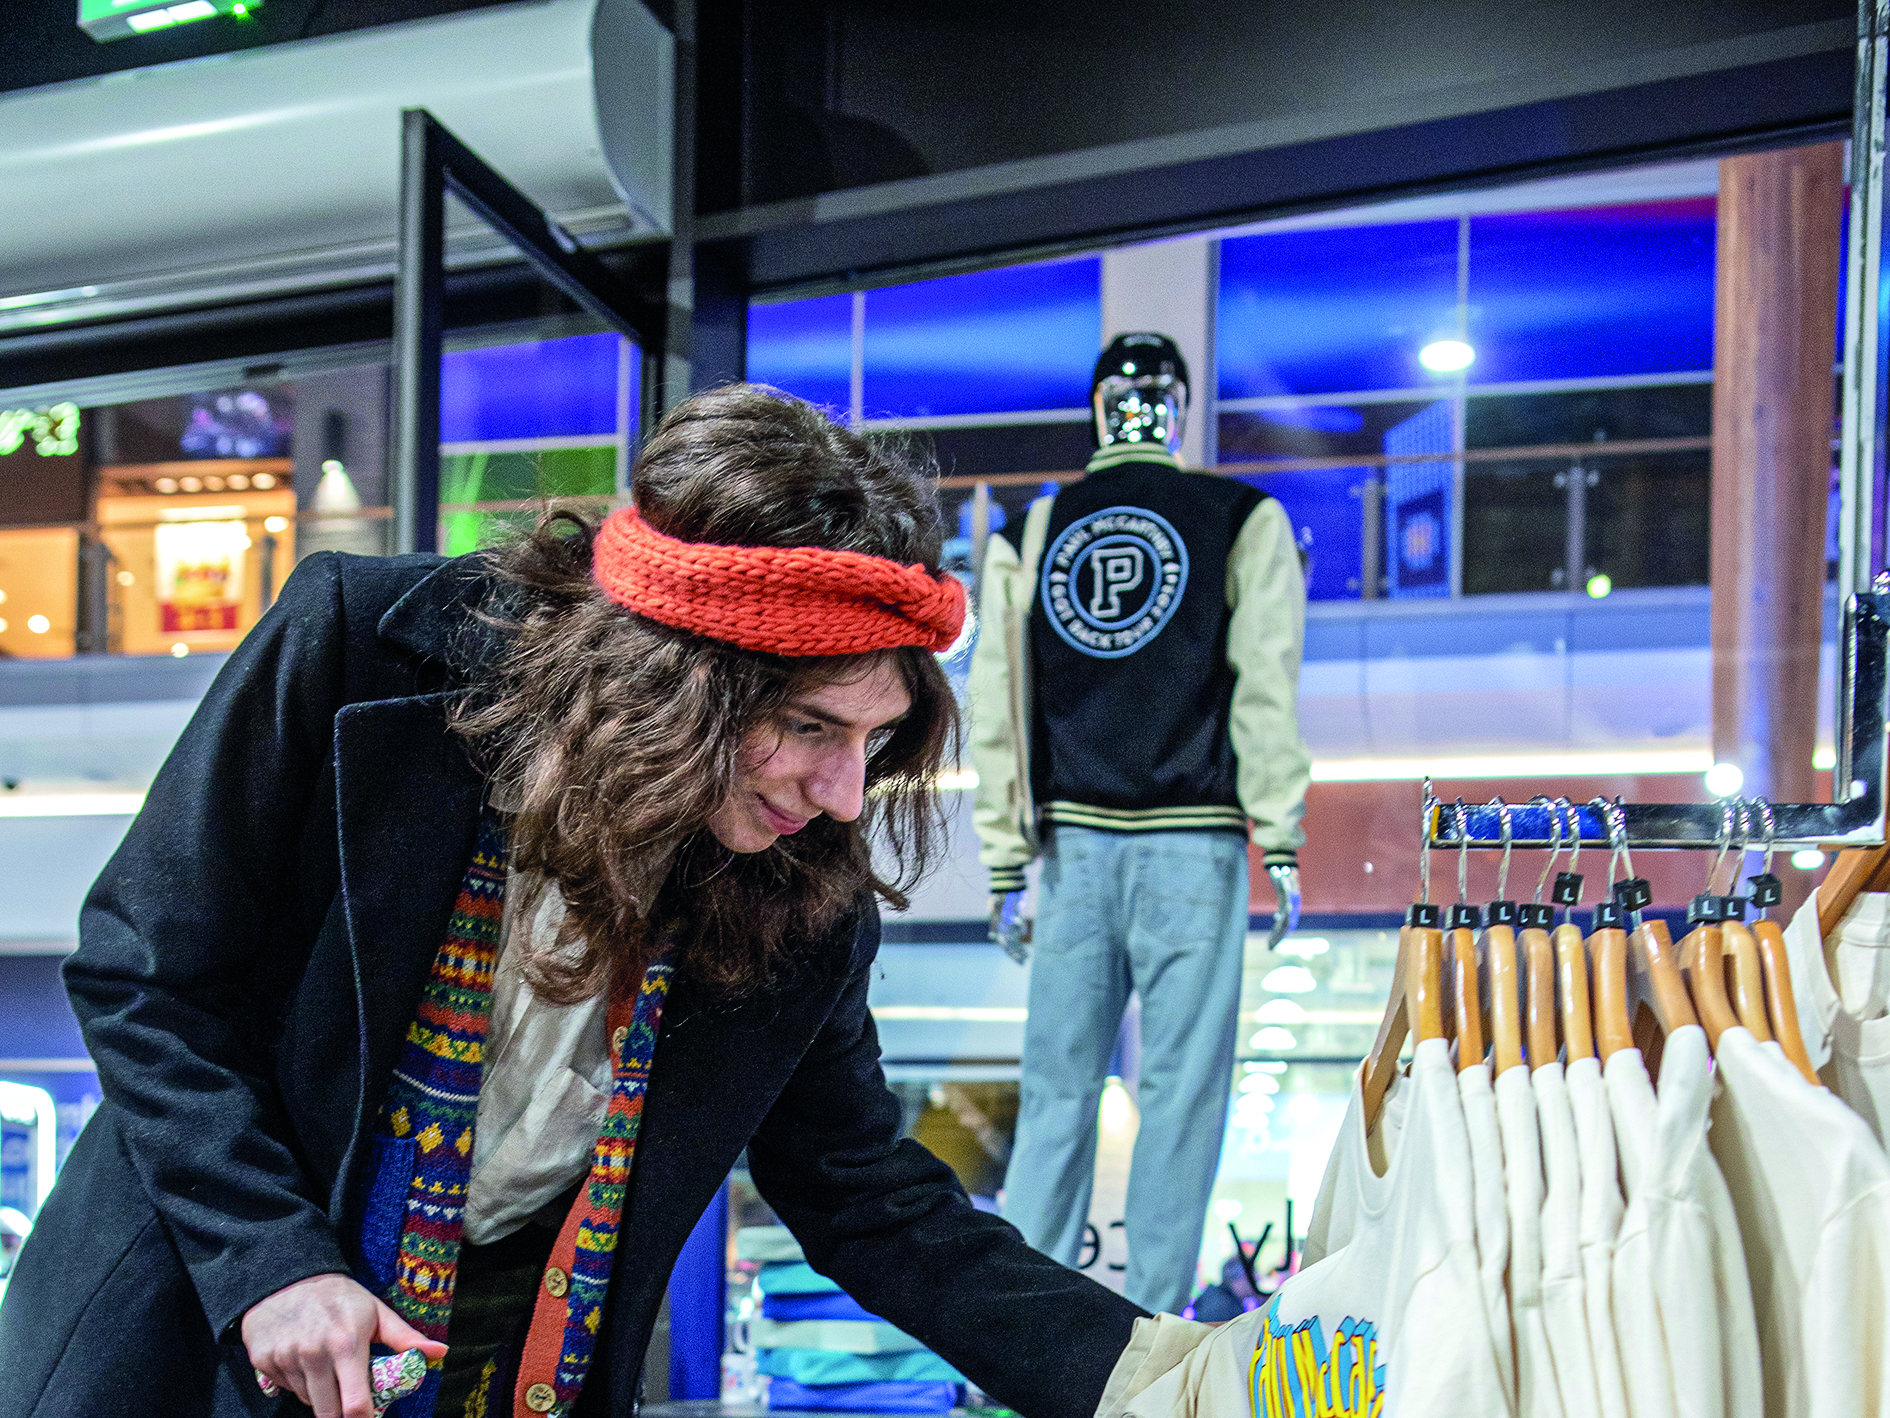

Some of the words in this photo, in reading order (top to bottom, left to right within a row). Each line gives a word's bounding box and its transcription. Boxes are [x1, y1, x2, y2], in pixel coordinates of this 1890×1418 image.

[1055, 528, 1092, 568] PAUL
[1090, 546, 1144, 618] P
[1067, 618, 1112, 650] BACK
[1113, 616, 1154, 647] TOUR
[1562, 887, 1575, 902] L
[1635, 890, 1647, 904] L
[1764, 888, 1776, 903] L
[1499, 906, 1511, 921] L
[1603, 906, 1616, 922] L
[1702, 899, 1715, 915] L
[1727, 901, 1739, 916] L
[1419, 908, 1432, 924] L
[1459, 908, 1471, 924] L
[1537, 908, 1548, 924] L
